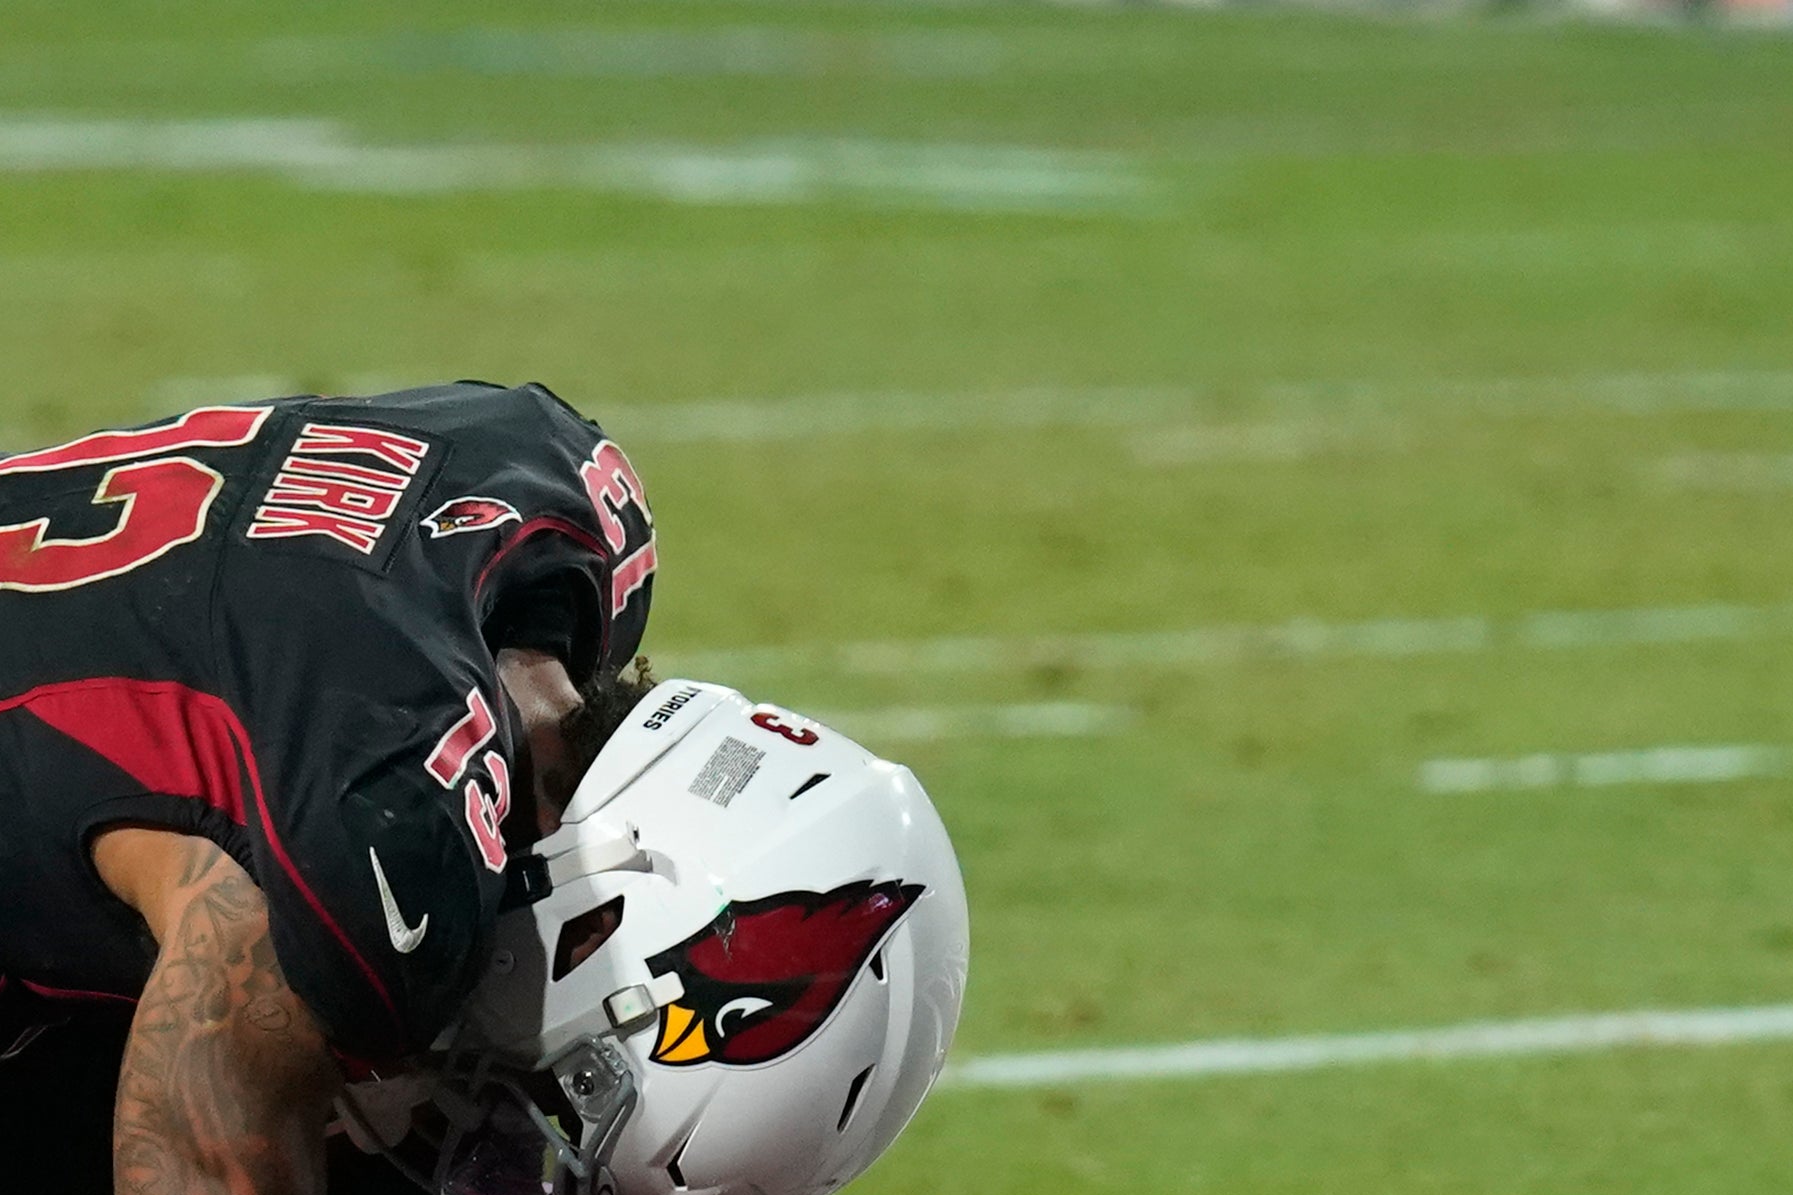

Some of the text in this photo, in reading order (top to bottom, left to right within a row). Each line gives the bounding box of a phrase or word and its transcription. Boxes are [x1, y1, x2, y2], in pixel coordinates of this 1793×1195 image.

[246, 423, 430, 556] KIRK
[579, 439, 657, 620] 13
[424, 686, 510, 874] 13
[750, 712, 819, 746] 3
